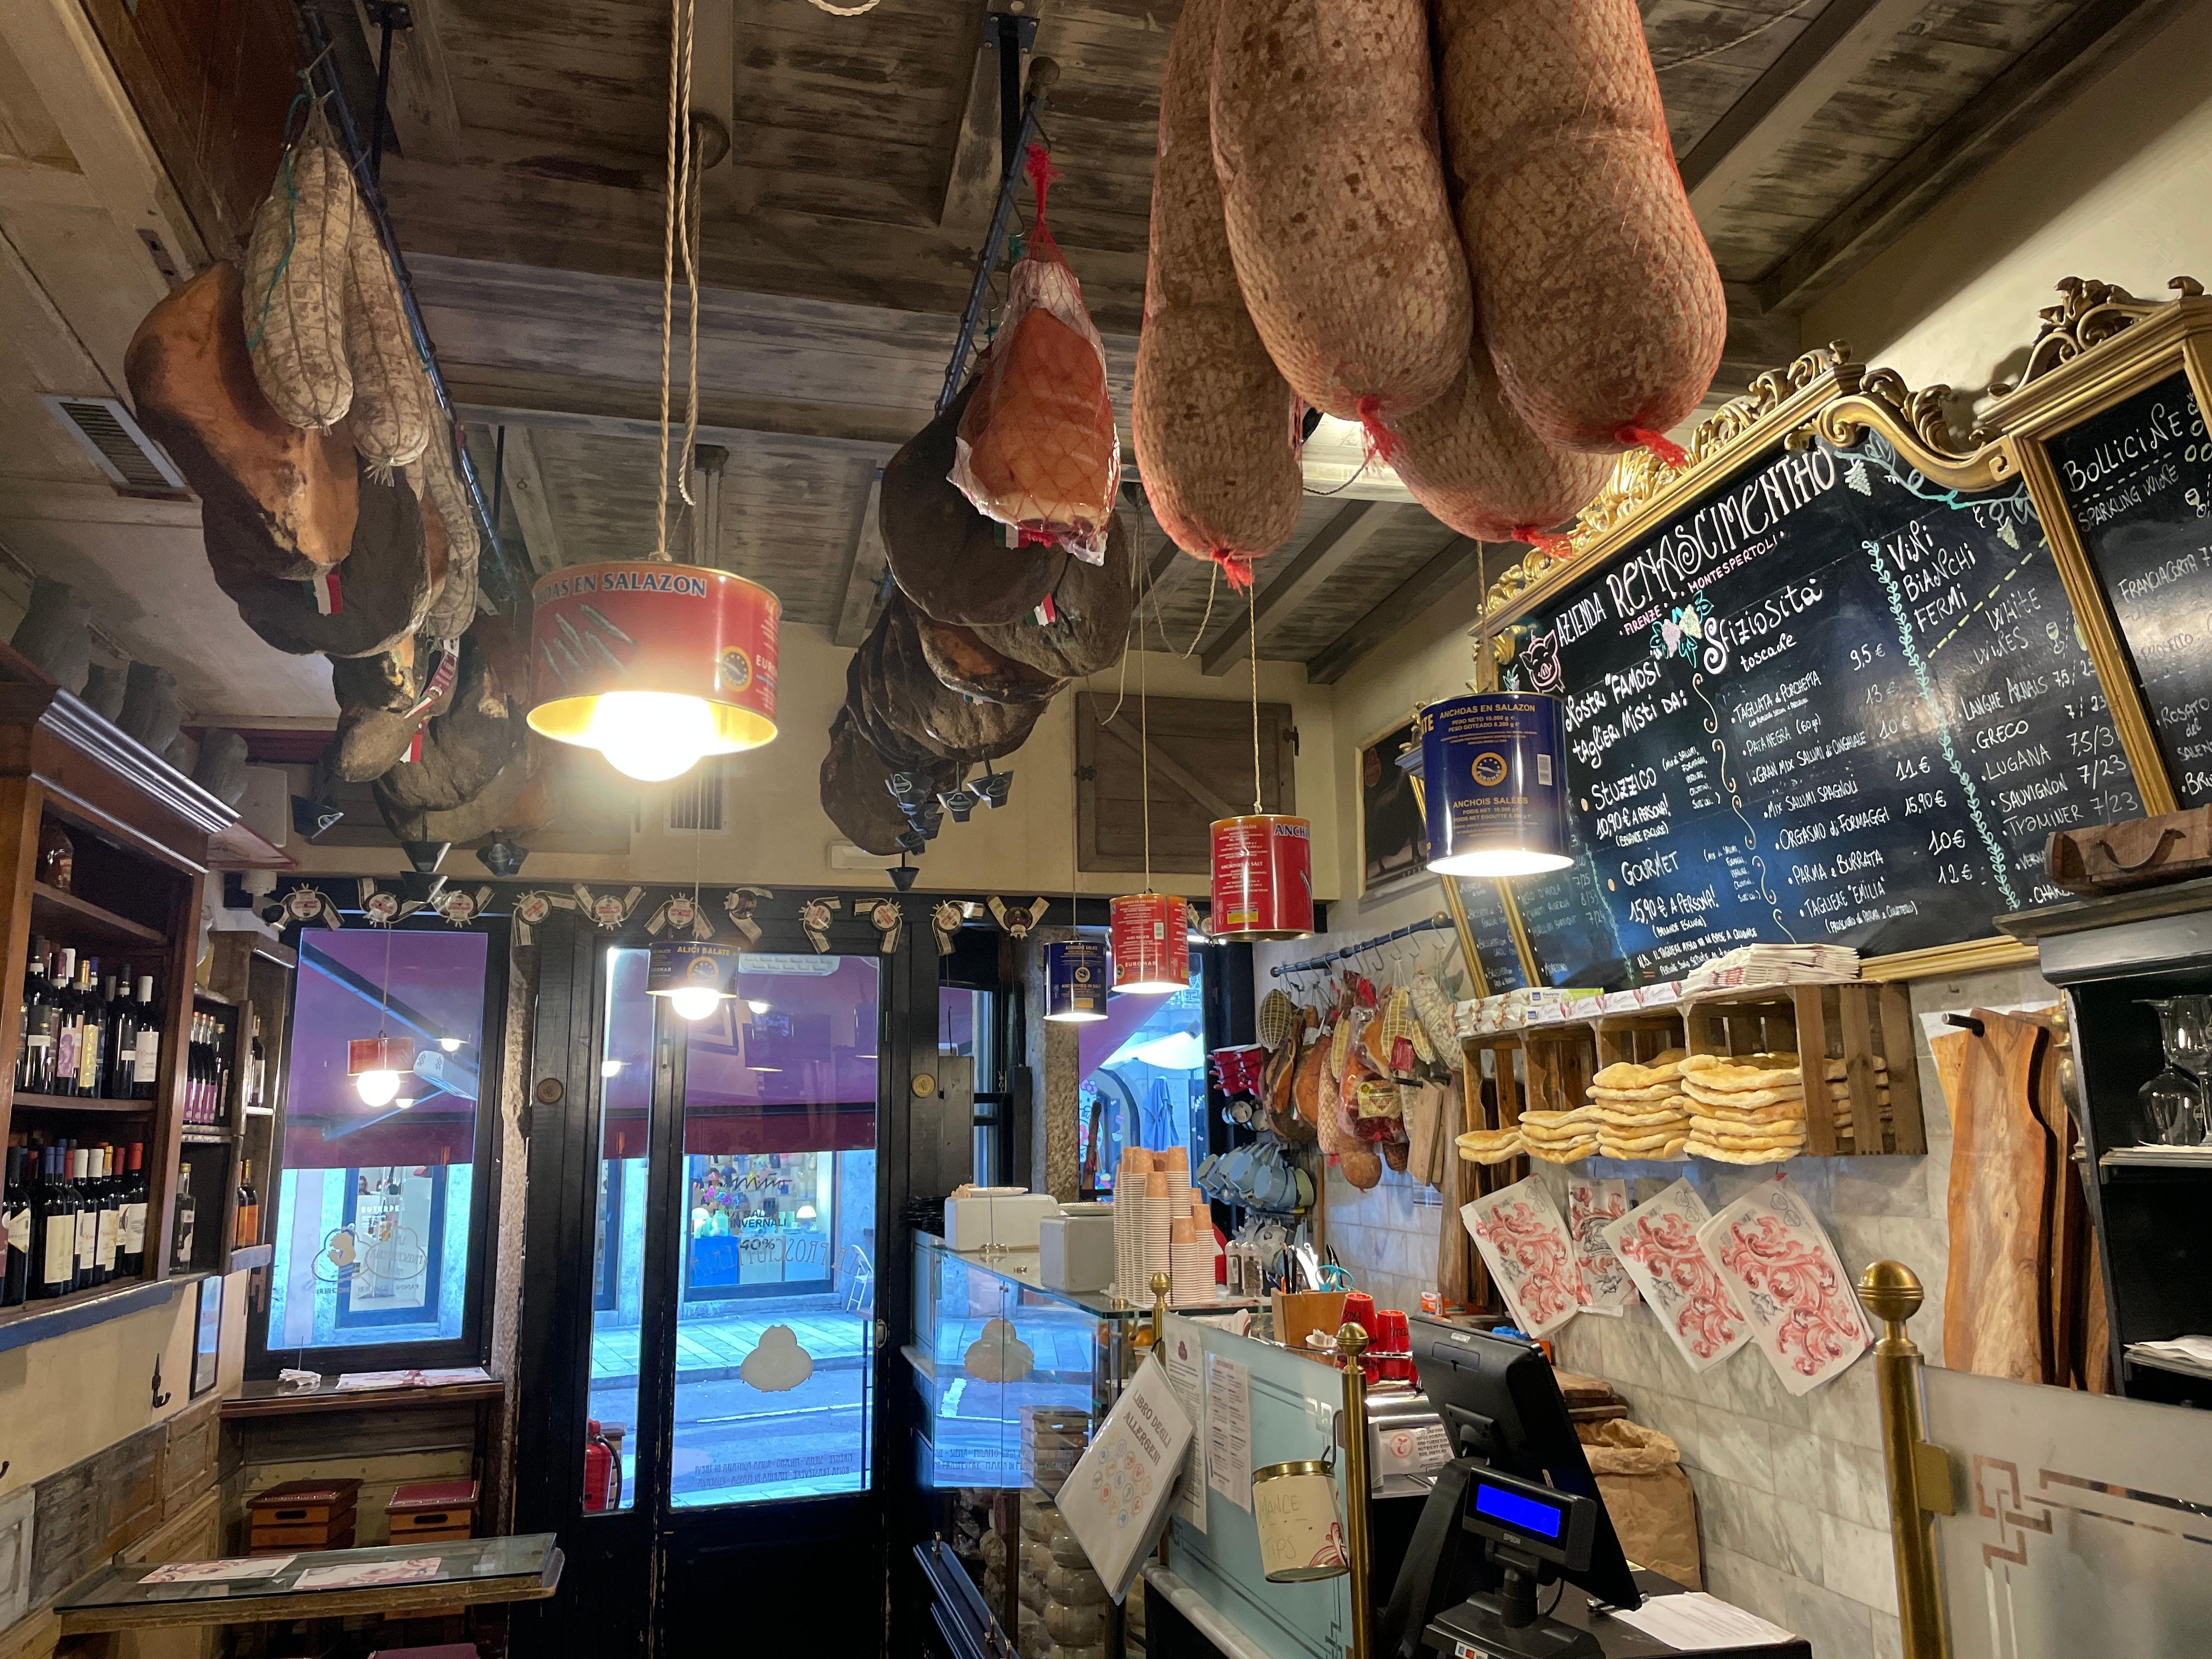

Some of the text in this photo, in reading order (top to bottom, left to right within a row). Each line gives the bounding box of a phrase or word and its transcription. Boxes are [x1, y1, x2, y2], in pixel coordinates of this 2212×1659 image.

[2078, 464, 2179, 532] SPARKLING WINE
[1555, 445, 1836, 647] AZIENDA RENASCIMENTHO
[574, 573, 597, 593] EN
[603, 572, 707, 599] SALAZON
[1624, 535, 1779, 636] FIRENZE MONTESPERTOLI
[2118, 554, 2198, 603] FRANCIACORTA
[1850, 644, 1871, 670] 9,5
[1875, 643, 1886, 658] €
[1440, 706, 1478, 719] ANCHOAS
[1495, 703, 1535, 712] SALAZON
[1733, 694, 1773, 724] TAGLIATA
[1780, 670, 1821, 702] PORCHETTA
[1866, 684, 1882, 705] 13
[1960, 691, 2004, 721] LANGHE
[2160, 697, 2210, 729] ROSATO
[1746, 737, 1767, 757] PATA
[1765, 726, 1792, 748] NEGRA
[1879, 719, 1898, 740] 10
[1976, 720, 2029, 749] GRECO
[1756, 761, 1779, 783] GRAN
[1779, 758, 1795, 775] MIX
[1797, 740, 1825, 766] SALUMI
[1895, 759, 1918, 782] 11
[1918, 755, 1931, 774] €
[1985, 744, 2052, 780] LUGANA
[1934, 789, 1947, 808] €
[1999, 754, 2126, 813] SAUVIGNON 7/23
[1453, 795, 1528, 809] ANCHOIS SALÉES
[1632, 810, 1639, 825] A
[1785, 791, 1816, 811] SALUMI
[2089, 790, 2138, 825] 7/23
[1779, 823, 1827, 851] ORGASMO
[1837, 806, 1891, 833] FORMAGGI
[1928, 830, 1952, 856] 10
[1952, 828, 1966, 849] €
[1621, 850, 1680, 887] GOURMET
[1791, 862, 1829, 887] PARMA
[1836, 849, 1884, 876] BURRATA
[1937, 864, 1960, 885] 12
[1961, 863, 1973, 881] €
[1670, 896, 1678, 914] A
[1676, 883, 1719, 915] PERSONA!
[1804, 889, 1848, 919] TAGLIERE
[702, 947, 730, 956] SALATE
[730, 1218, 786, 1228] INVERNALI
[1133, 1389, 1171, 1449] LIBRO DEGLI
[1123, 1412, 1161, 1466] ALLERGENI
[1259, 1494, 1300, 1520] MANCE
